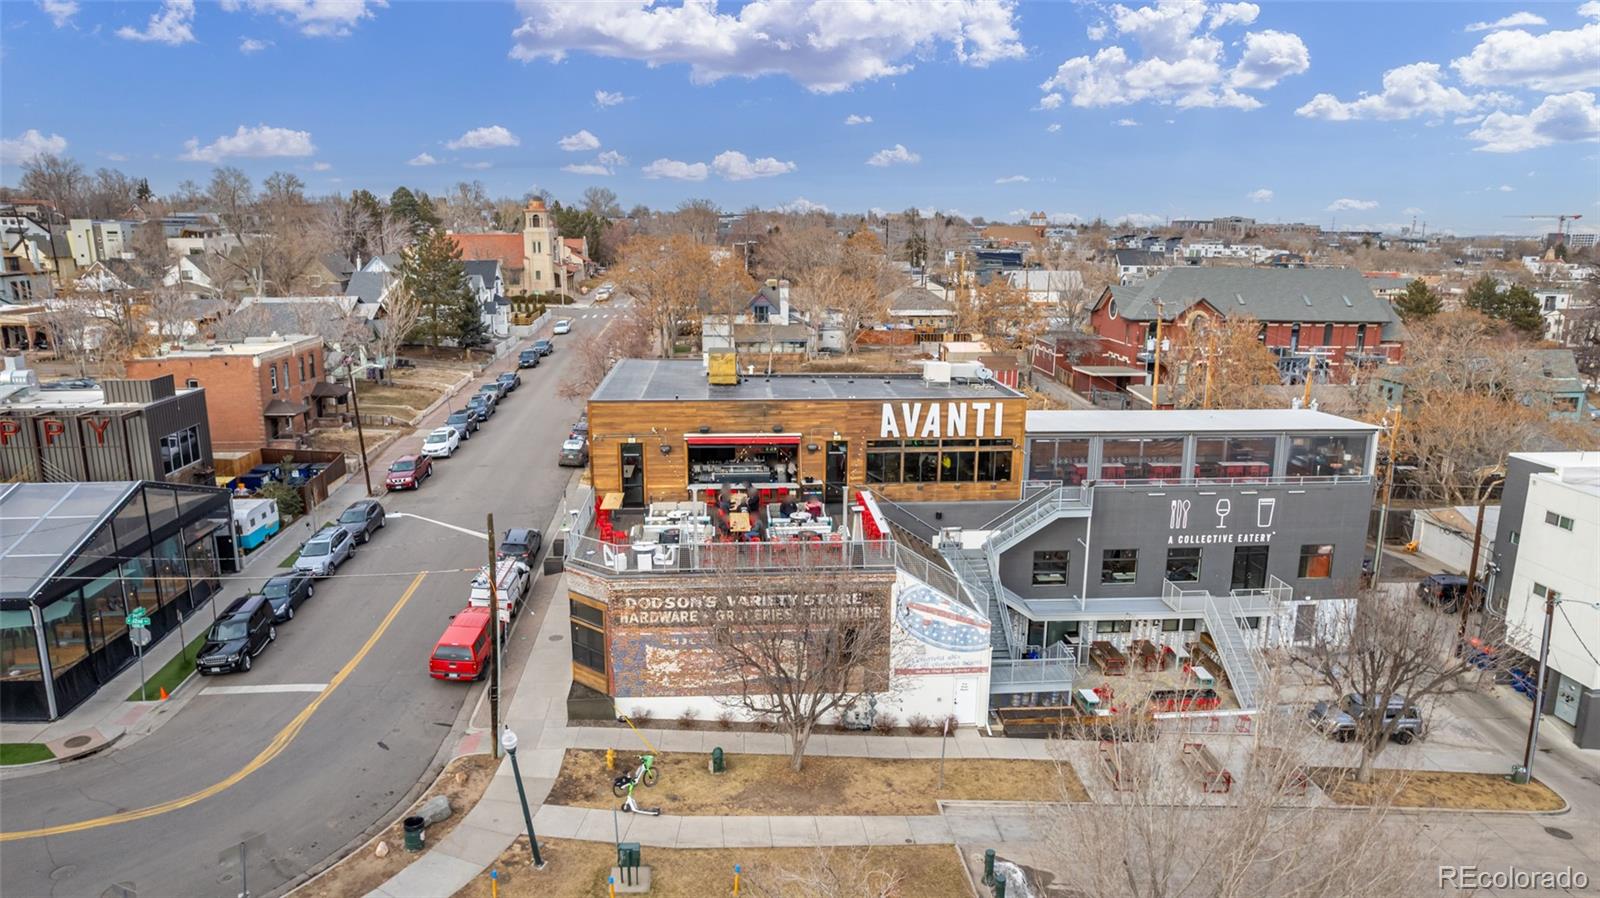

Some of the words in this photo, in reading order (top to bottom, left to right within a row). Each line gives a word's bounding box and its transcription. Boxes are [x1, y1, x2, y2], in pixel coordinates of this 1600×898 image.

[880, 402, 1004, 438] AVANTI
[1168, 535, 1174, 545] A
[1178, 534, 1234, 544] COLLECTIVE
[1237, 533, 1272, 543] EATERY
[624, 595, 718, 609] DODSON'S
[726, 594, 799, 607] VARIETY
[803, 592, 863, 606] STORE
[619, 610, 699, 624] HARDWARE
[715, 608, 792, 622] GRCERIES
